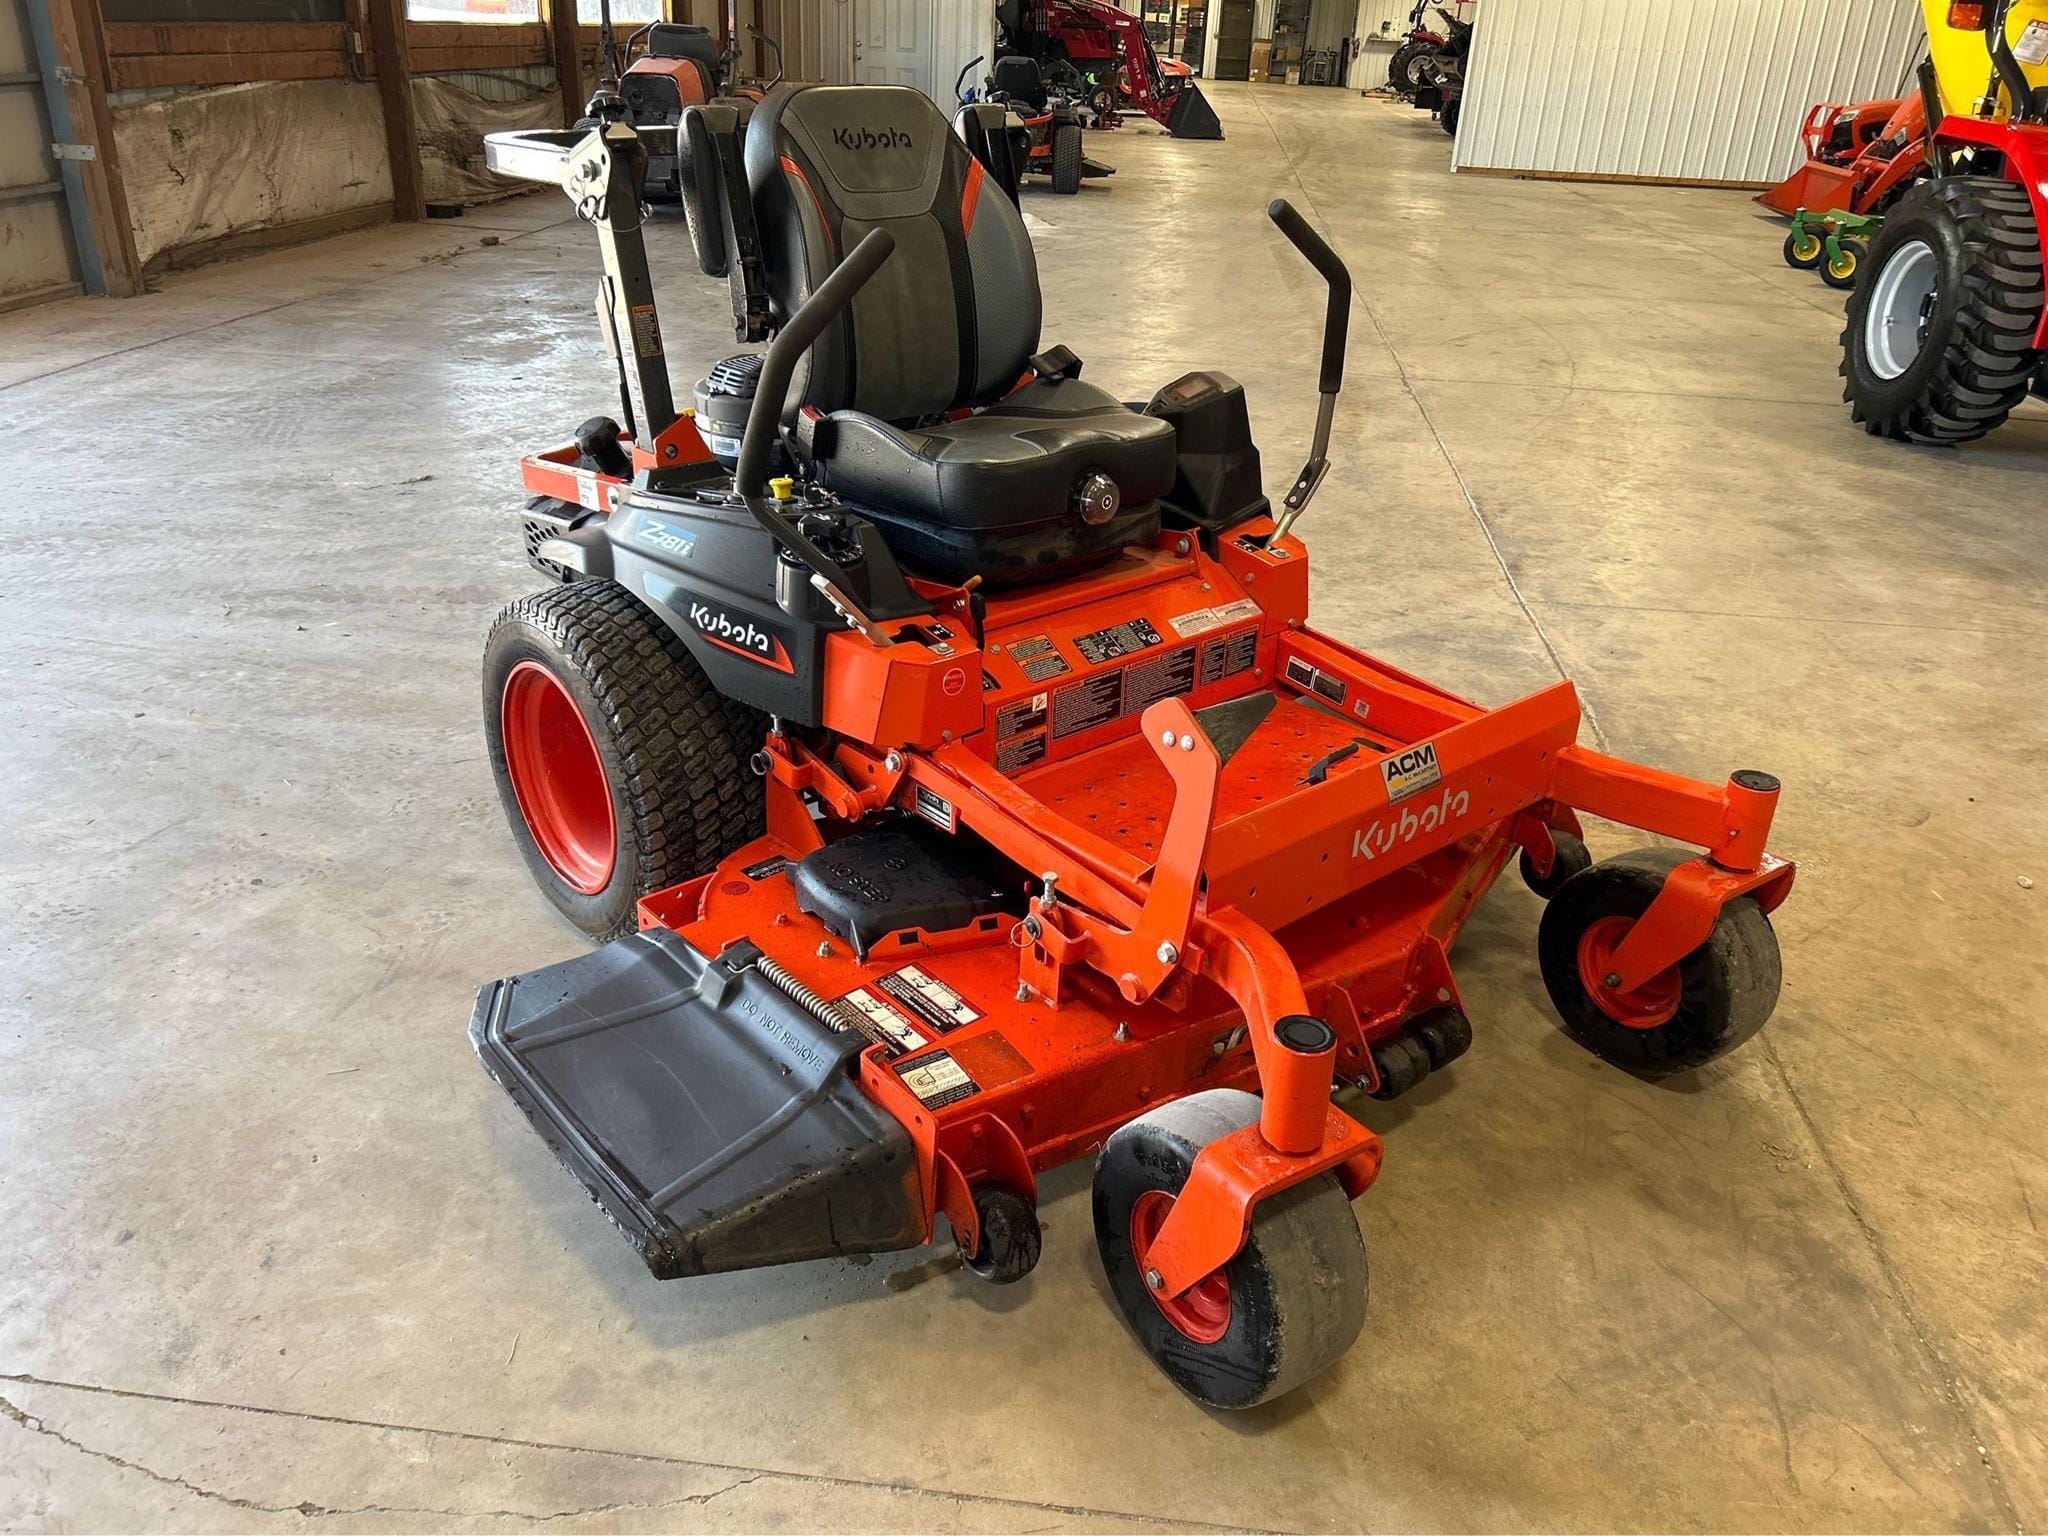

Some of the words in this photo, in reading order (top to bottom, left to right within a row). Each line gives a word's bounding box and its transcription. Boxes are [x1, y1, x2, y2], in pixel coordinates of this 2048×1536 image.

[832, 126, 912, 150] Kubota
[689, 602, 769, 652] Kubota
[1387, 745, 1435, 781] ACM
[1351, 787, 1470, 860] Kubota
[742, 997, 759, 1017] DO
[759, 1012, 782, 1036] NOT
[780, 1029, 825, 1073] REMOVE
